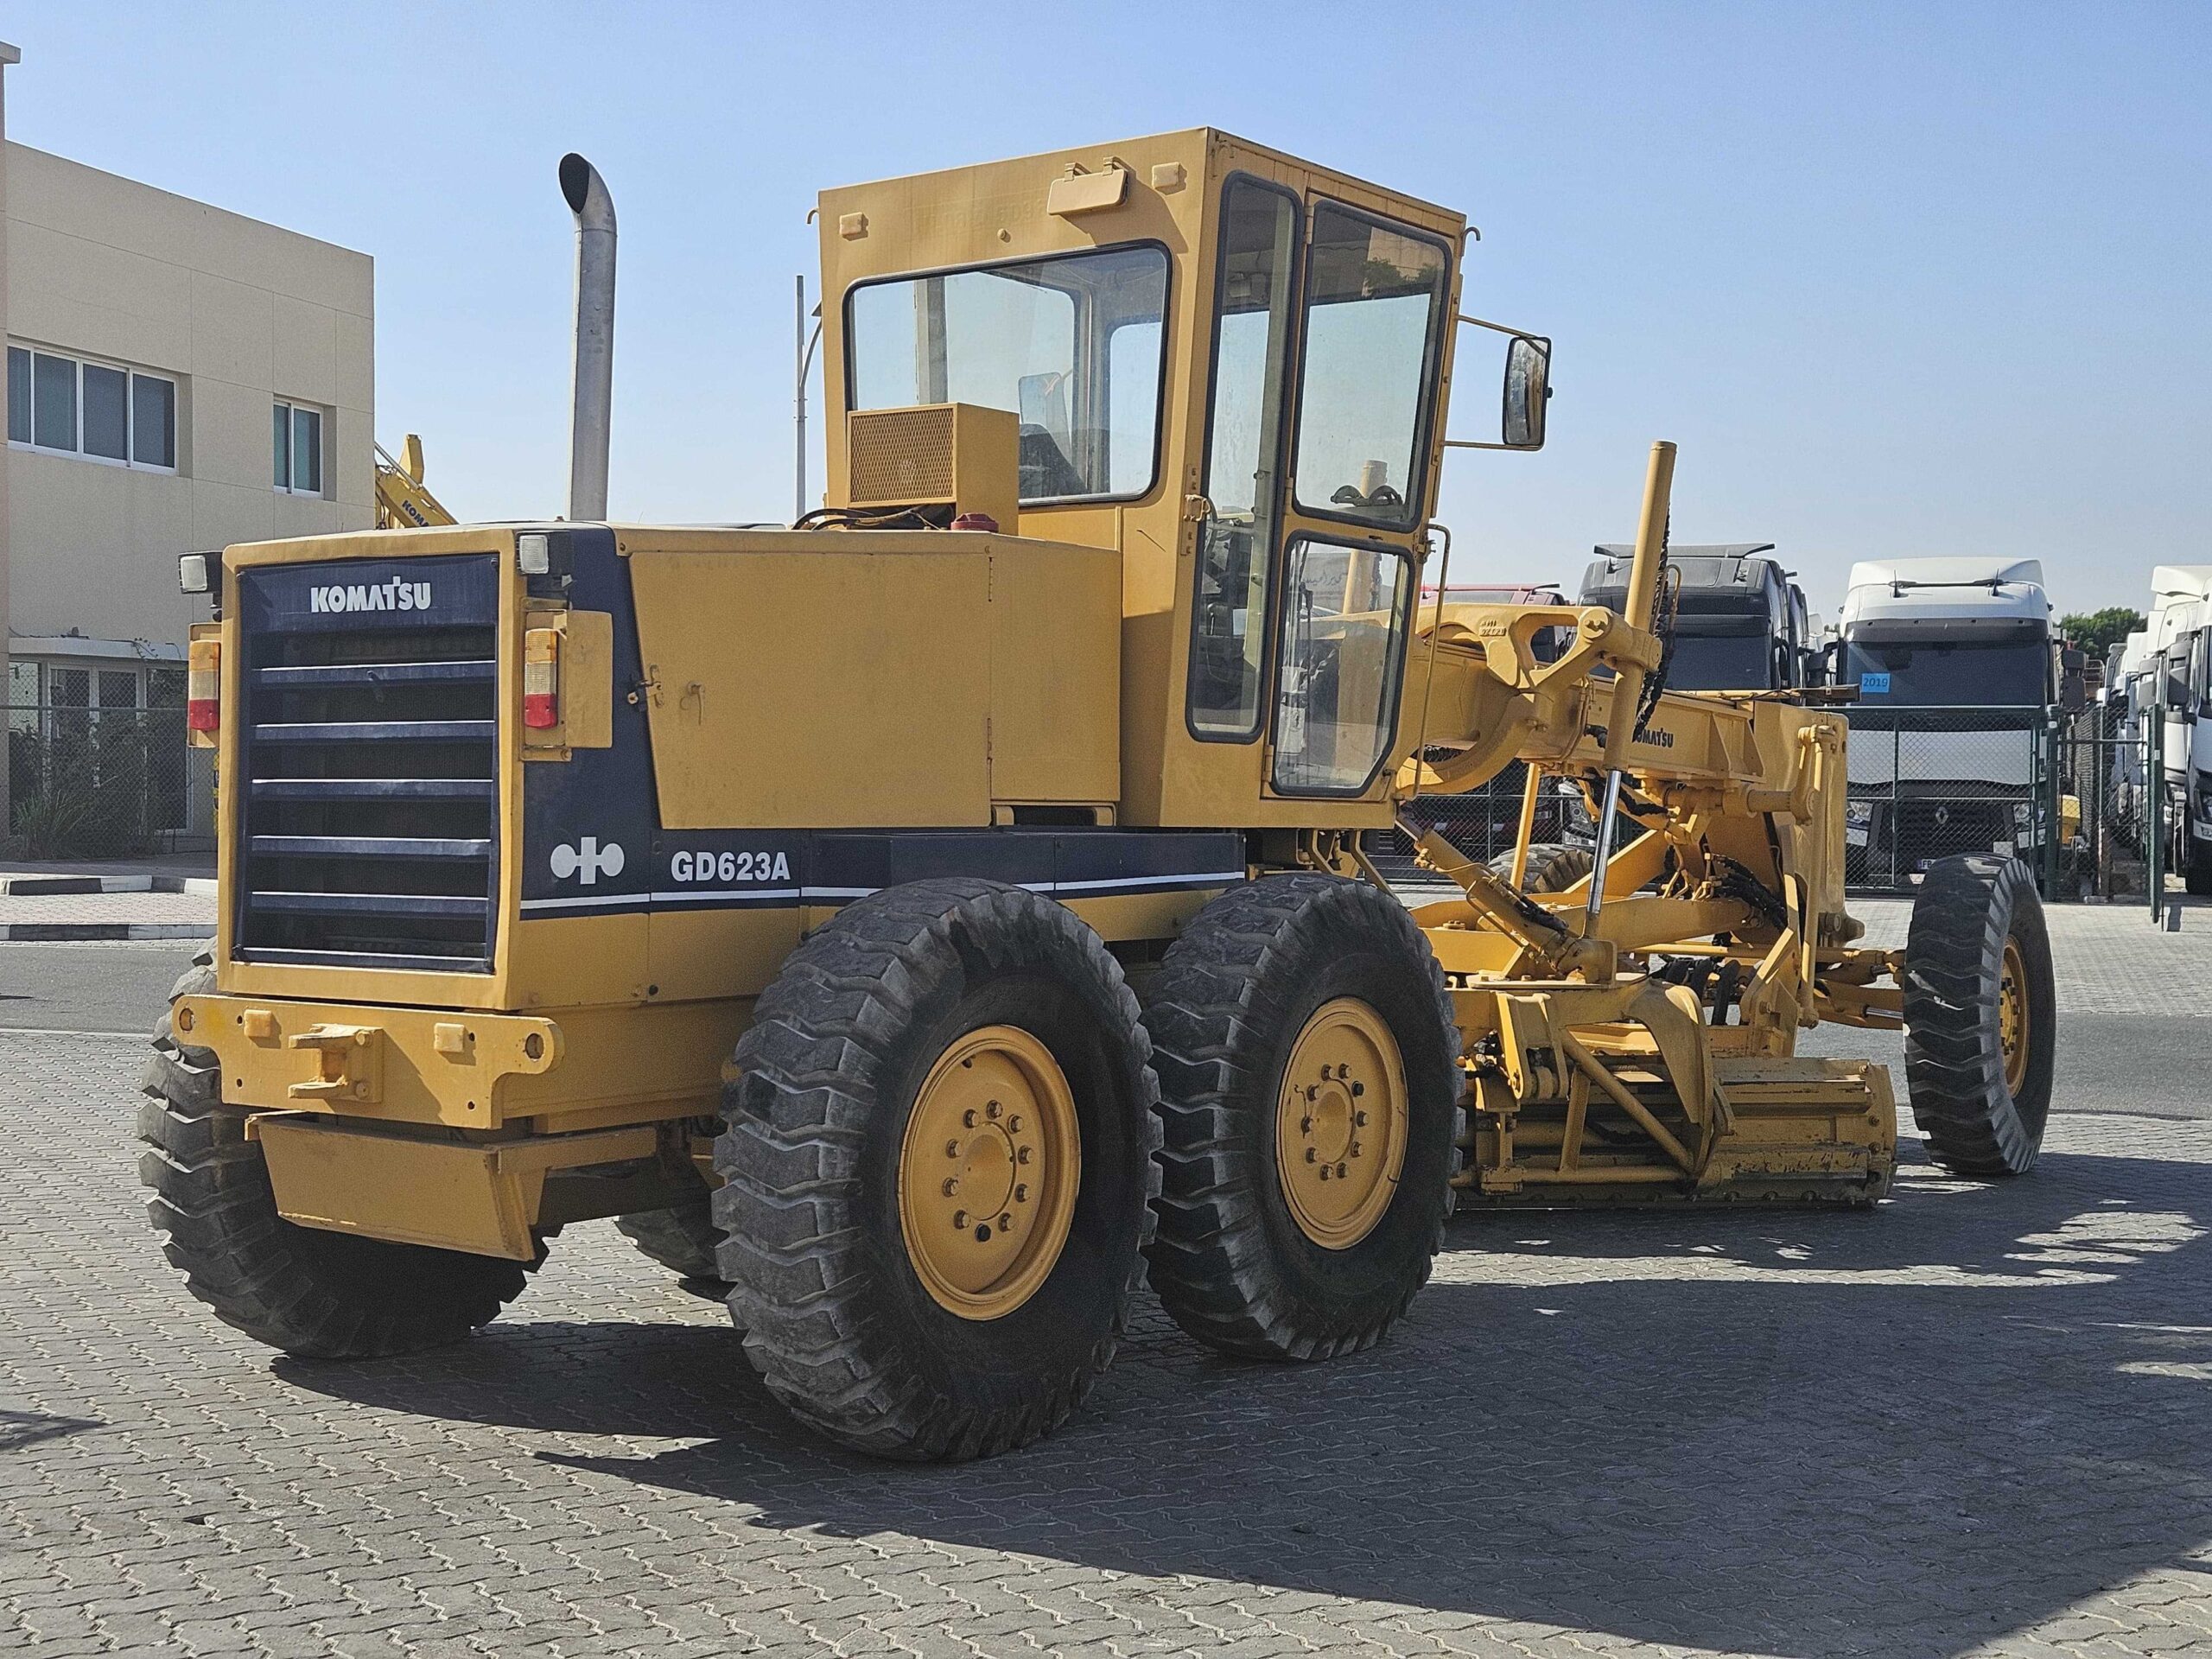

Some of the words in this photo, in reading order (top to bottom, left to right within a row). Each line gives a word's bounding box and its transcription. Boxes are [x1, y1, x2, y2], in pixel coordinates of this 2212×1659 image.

[310, 575, 431, 613] KOMATSU
[1863, 677, 1889, 687] 2019
[1636, 728, 1674, 748] OMATSU
[671, 850, 791, 881] GD623A
